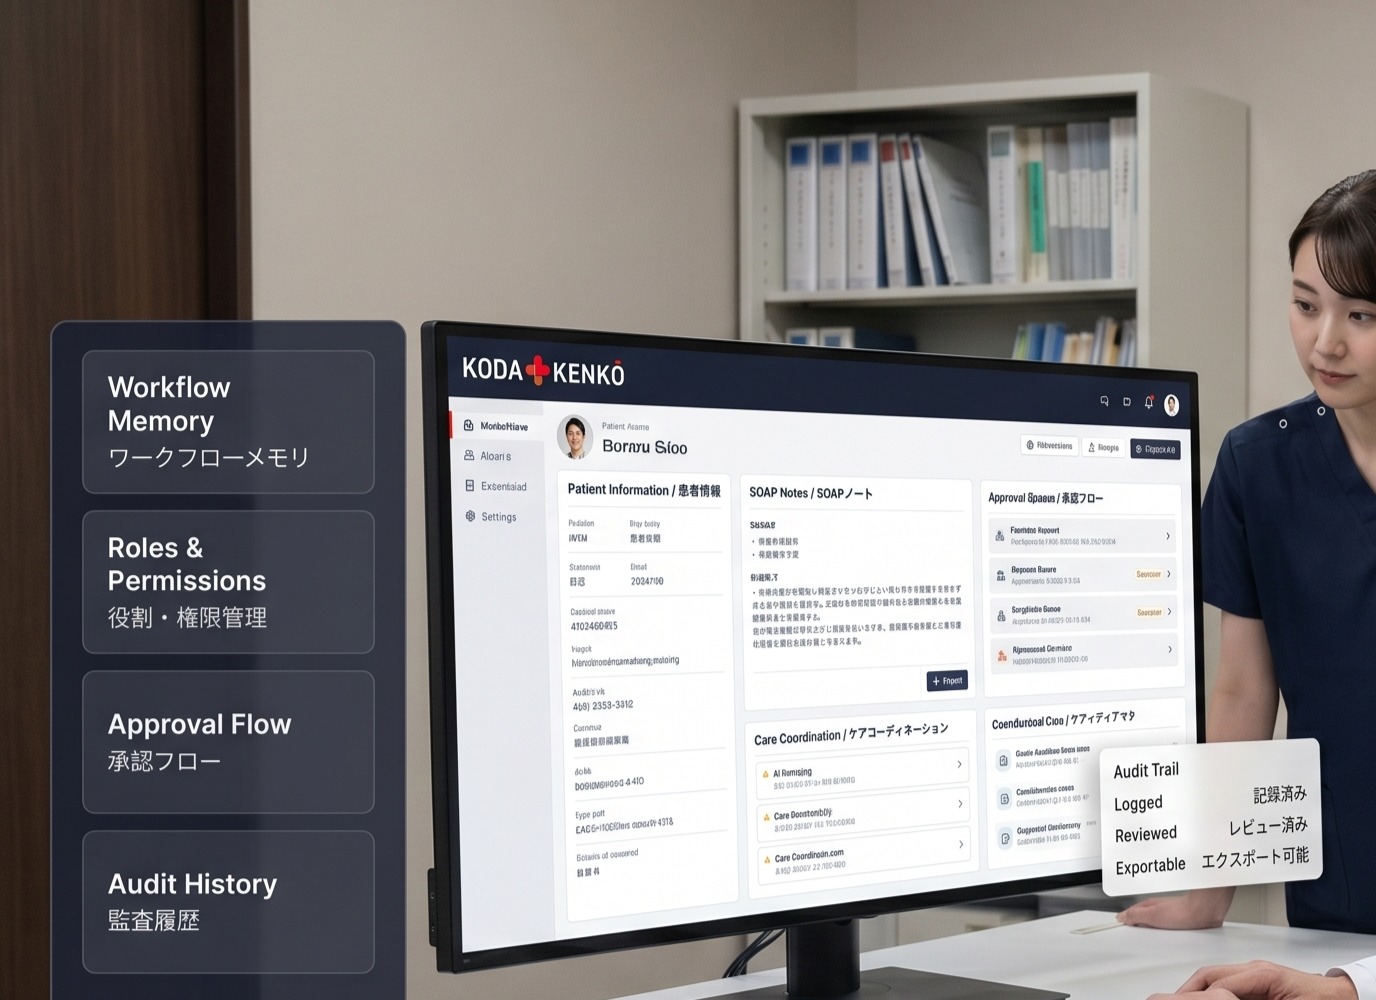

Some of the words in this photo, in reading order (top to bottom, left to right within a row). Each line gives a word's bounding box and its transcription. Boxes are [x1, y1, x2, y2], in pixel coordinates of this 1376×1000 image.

[462, 357, 523, 380] KODA
[602, 422, 625, 431] Patient
[568, 483, 606, 495] Patient
[609, 484, 669, 496] Information
[750, 487, 777, 498] SOAP
[780, 488, 808, 499] Notes
[817, 488, 872, 500] SOAPノート
[988, 492, 1025, 504] Approval
[482, 512, 516, 523] Settings
[754, 734, 777, 746] Care
[780, 730, 841, 744] Coordination
[849, 723, 949, 740] ケアコーディネーション
[775, 854, 790, 862] Care
